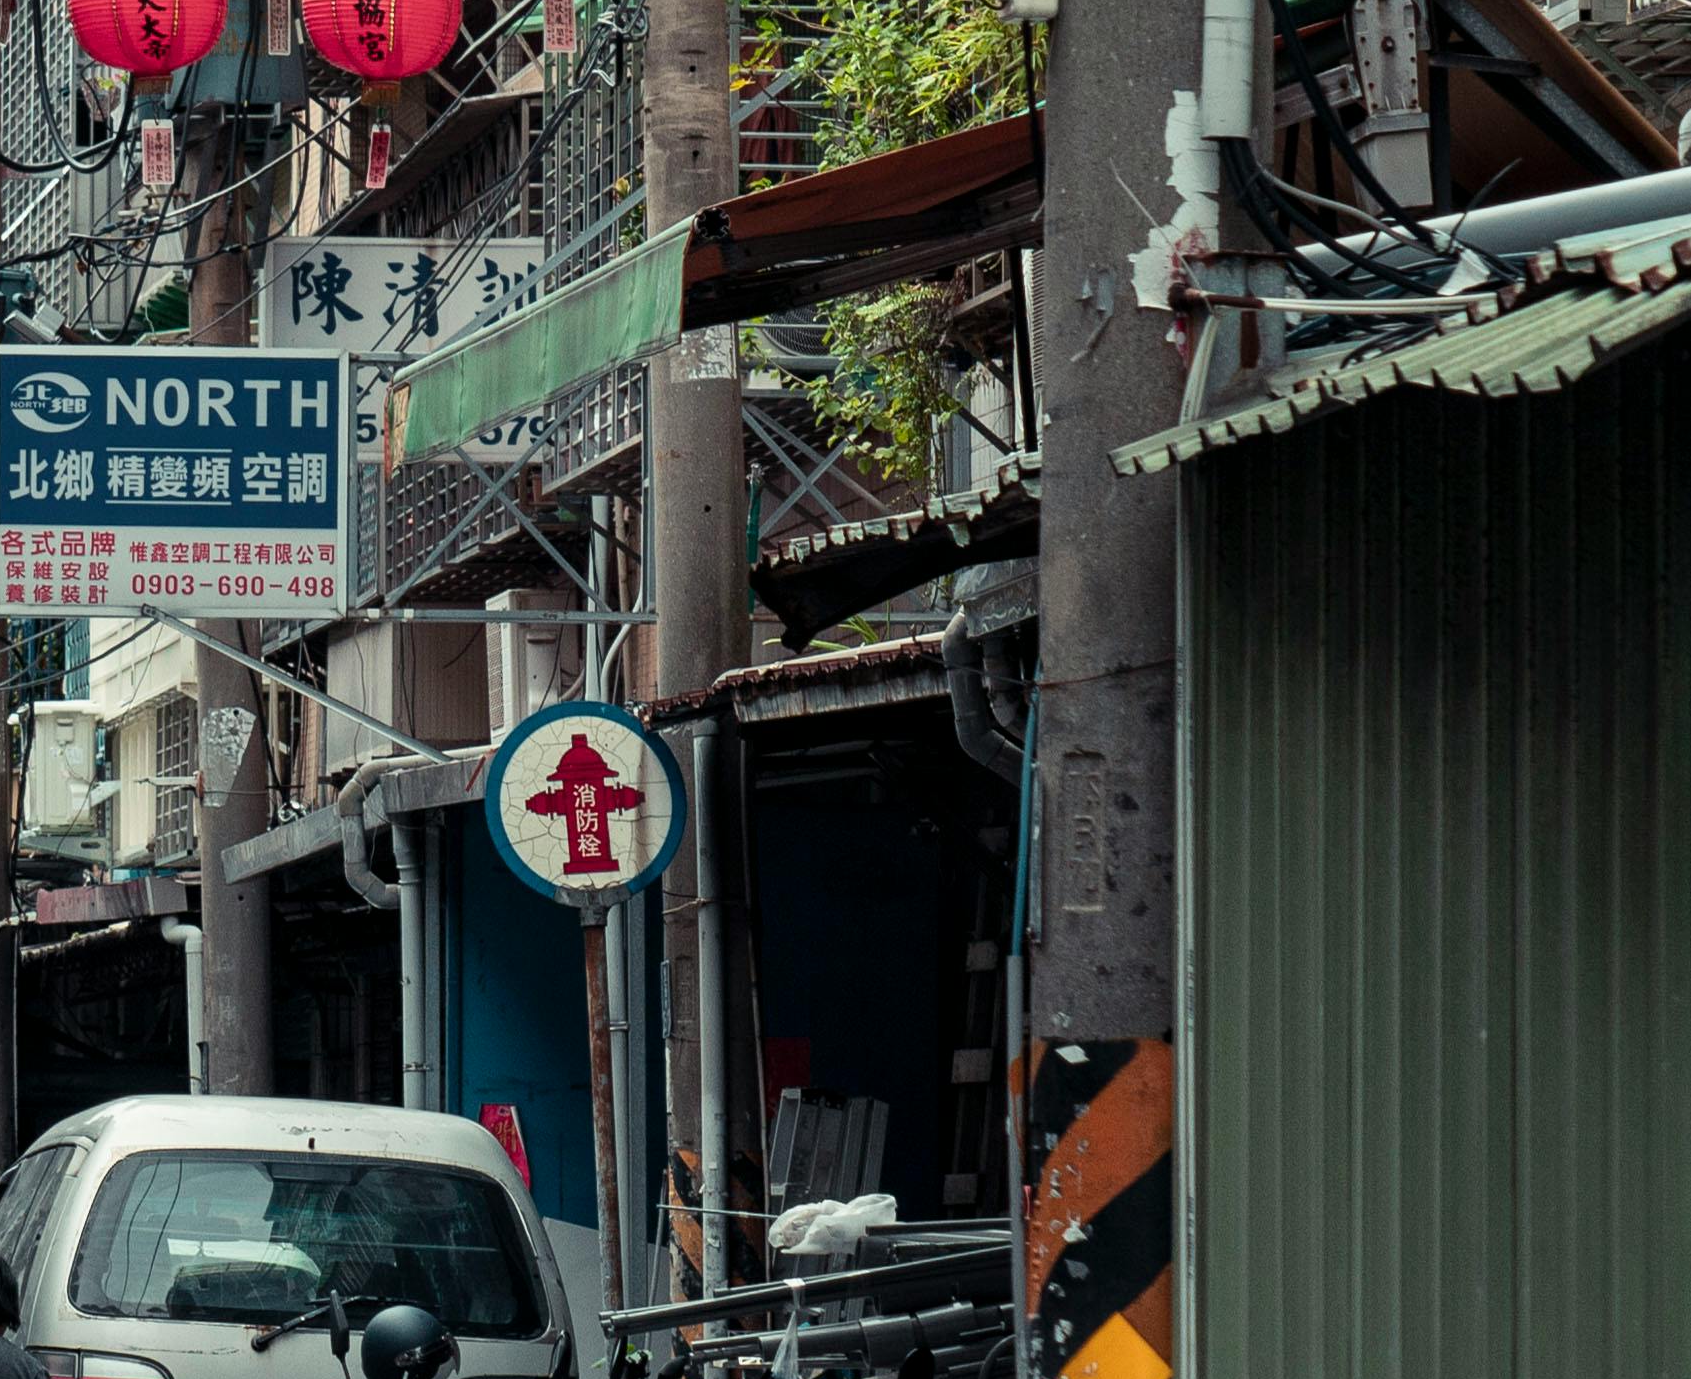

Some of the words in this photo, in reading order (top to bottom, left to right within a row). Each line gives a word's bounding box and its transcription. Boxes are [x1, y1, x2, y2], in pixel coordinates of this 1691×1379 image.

[10, 400, 47, 410] NORTH
[105, 377, 329, 428] NORTH
[9, 448, 95, 502] 北鄉
[106, 454, 231, 500] 精變頻
[241, 451, 328, 505] 空調
[0, 529, 116, 558] 各式品牌
[131, 574, 335, 599] 0903-690-498
[572, 783, 602, 858] 消防栓
